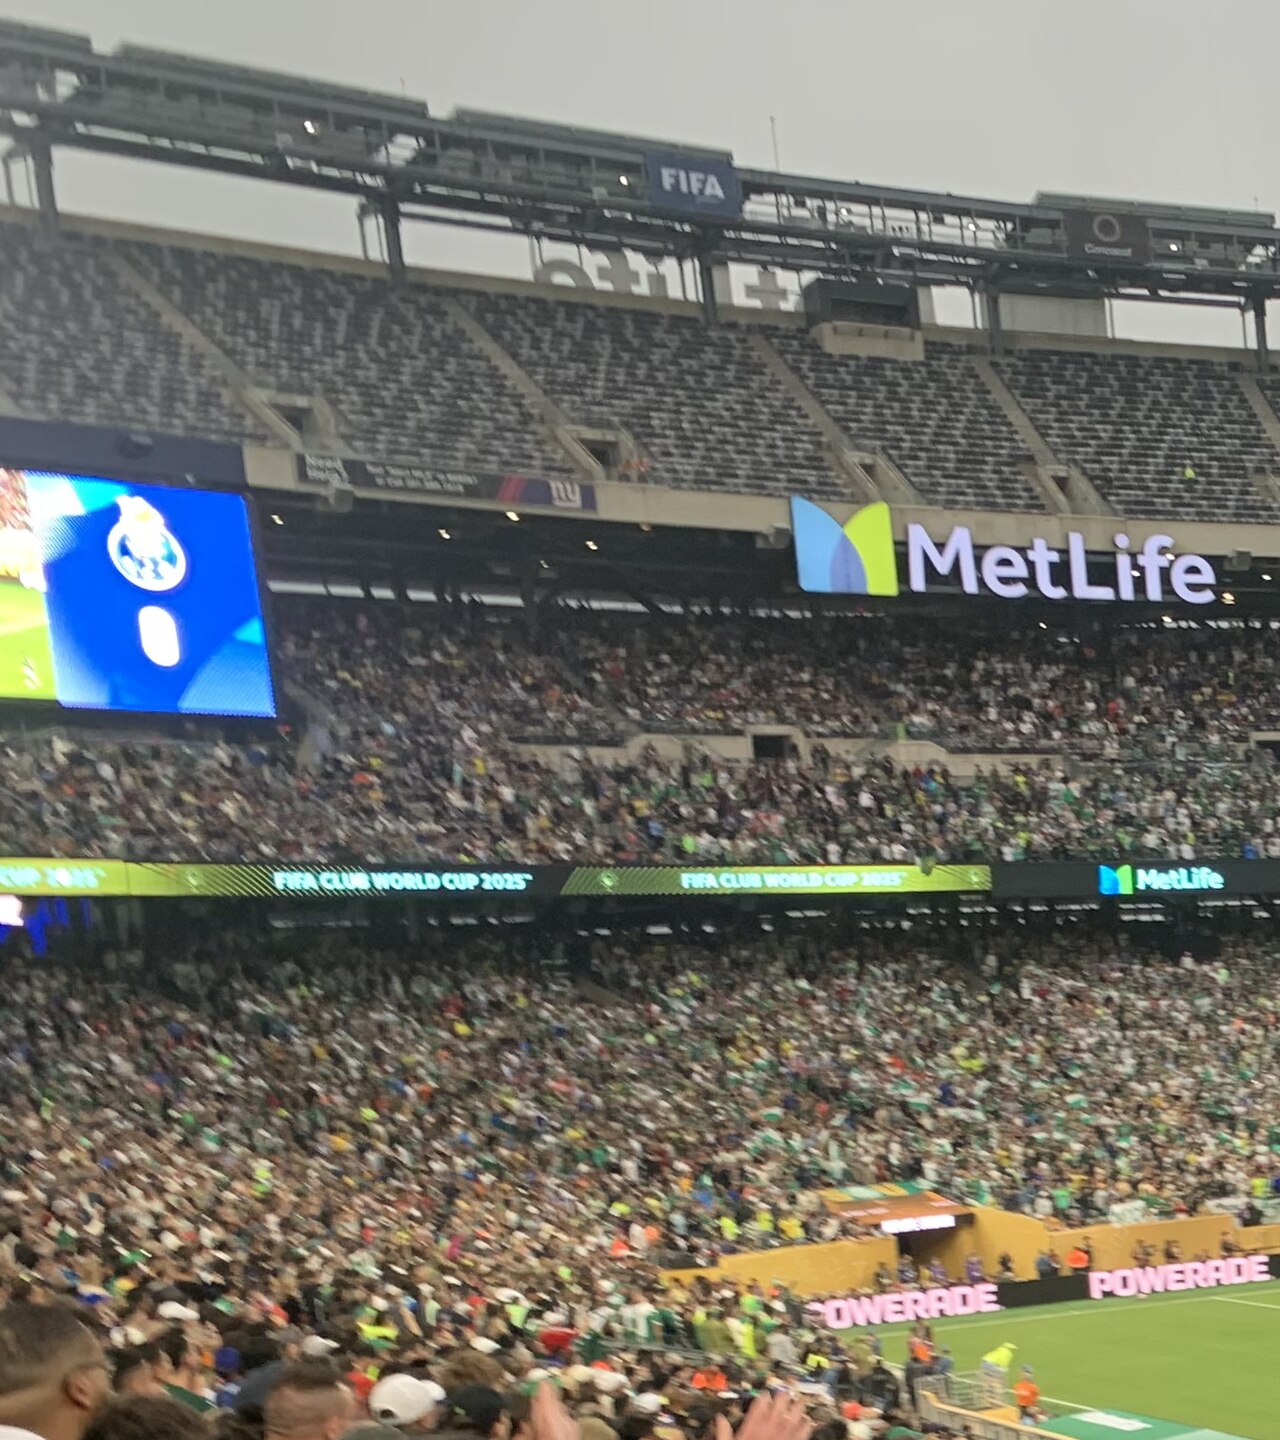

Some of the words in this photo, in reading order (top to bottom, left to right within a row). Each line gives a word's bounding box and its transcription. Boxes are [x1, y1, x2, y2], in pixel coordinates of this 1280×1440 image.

[660, 167, 725, 199] FIFA
[906, 523, 1217, 605] MetLife
[273, 871, 319, 890] FIFA
[319, 871, 371, 890] CLUB
[371, 872, 440, 890] WORLD
[441, 872, 479, 890] CUP
[681, 873, 719, 889] FIFA
[719, 873, 762, 889] CLUB
[763, 873, 824, 889] WORLD
[824, 872, 859, 888] CUP
[1136, 866, 1225, 890] MetLife
[1089, 1255, 1271, 1299] POWERADE
